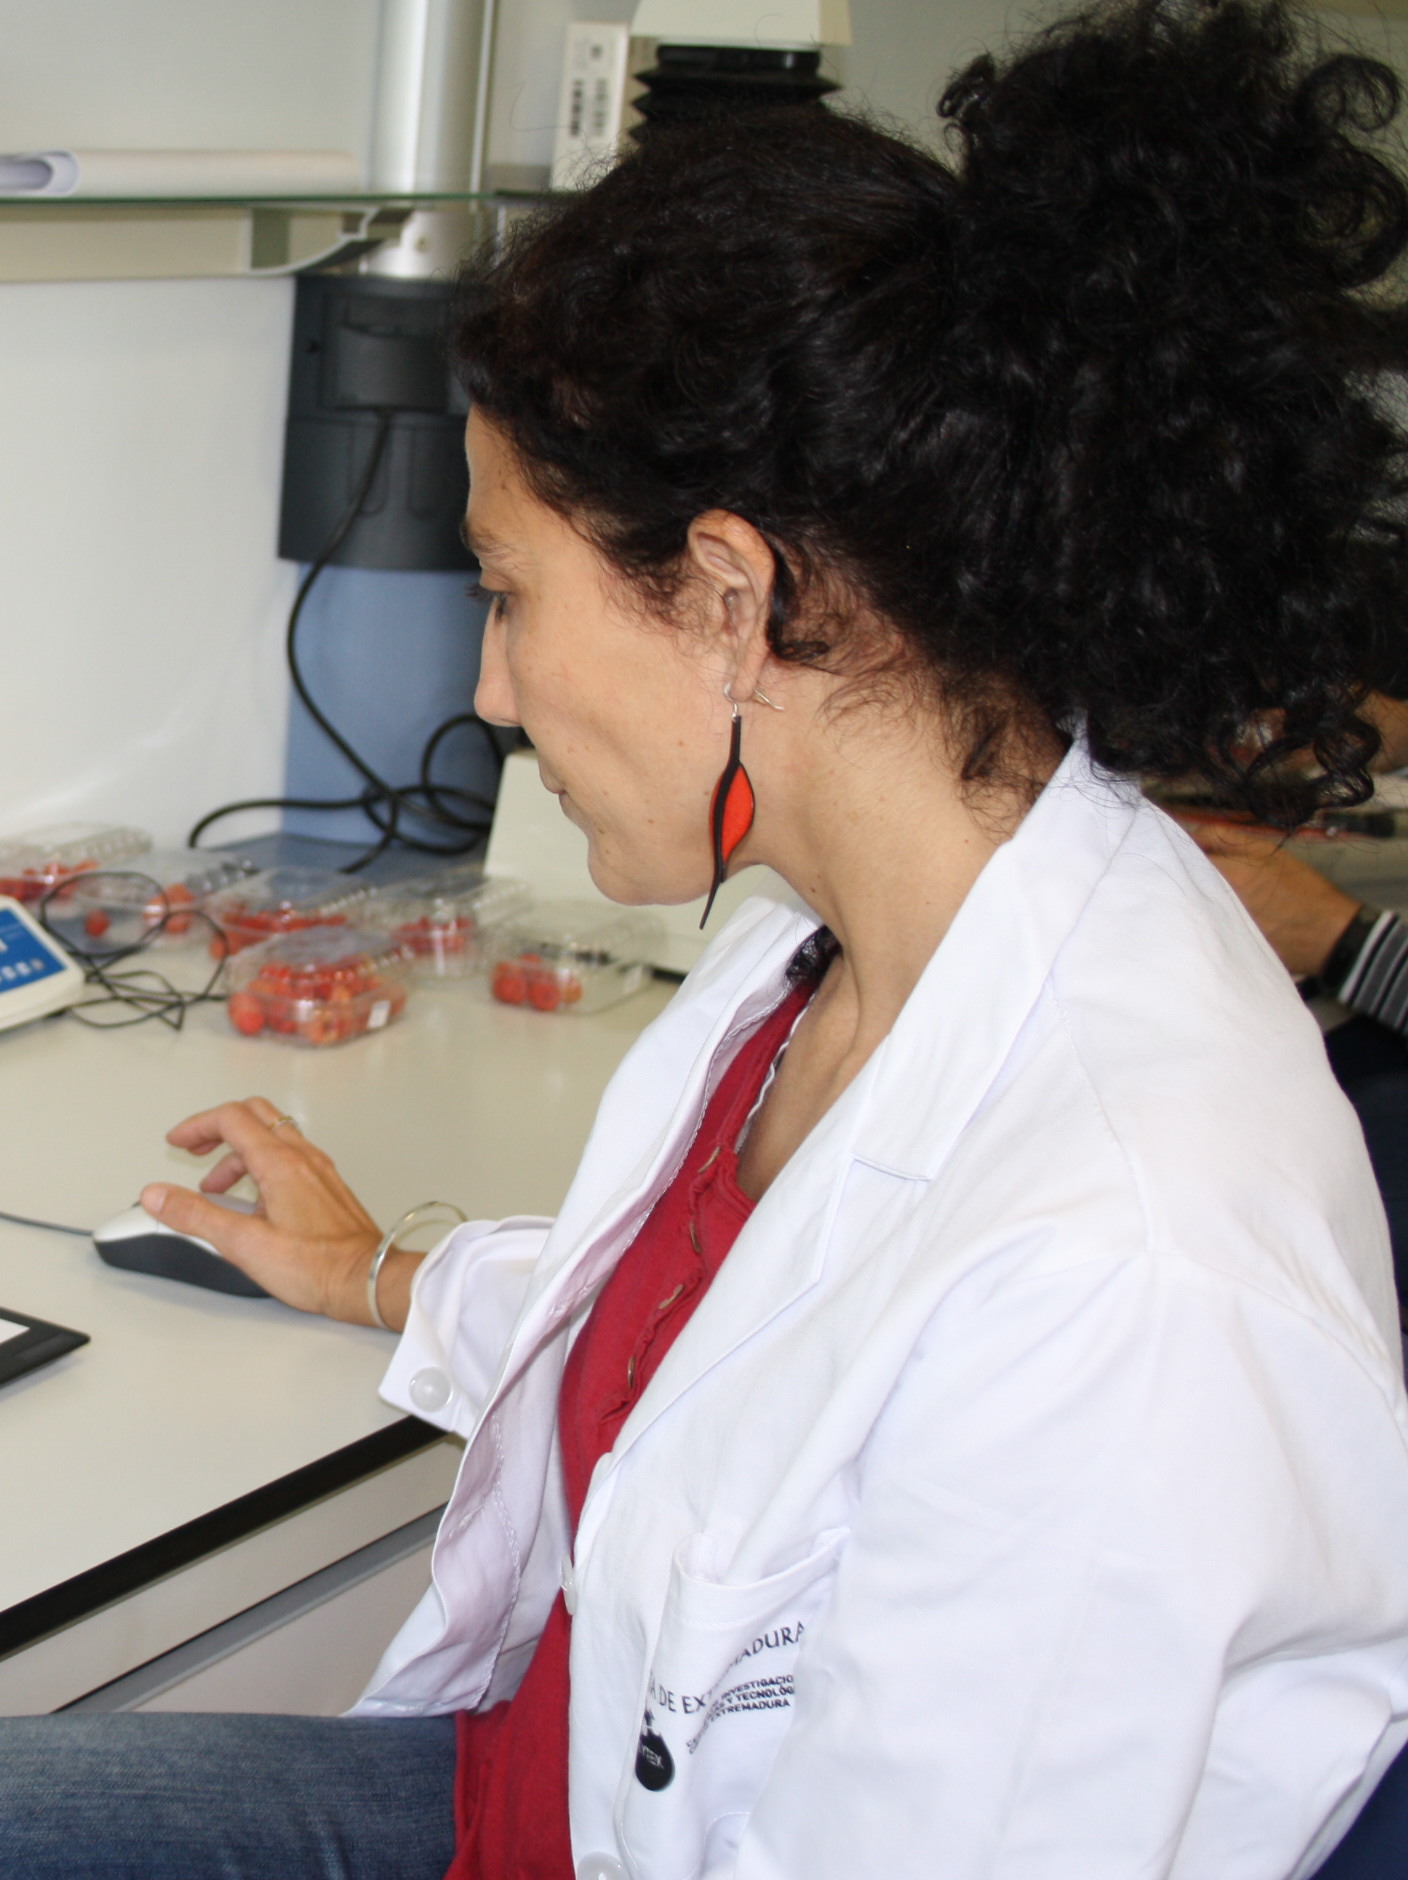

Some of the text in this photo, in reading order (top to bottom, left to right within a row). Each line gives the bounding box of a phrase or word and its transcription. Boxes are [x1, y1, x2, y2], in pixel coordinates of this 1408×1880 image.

[659, 1684, 676, 1713] DE
[721, 1674, 794, 1699] INVESTIGACIO
[736, 1685, 795, 1702] TECNOLÓG
